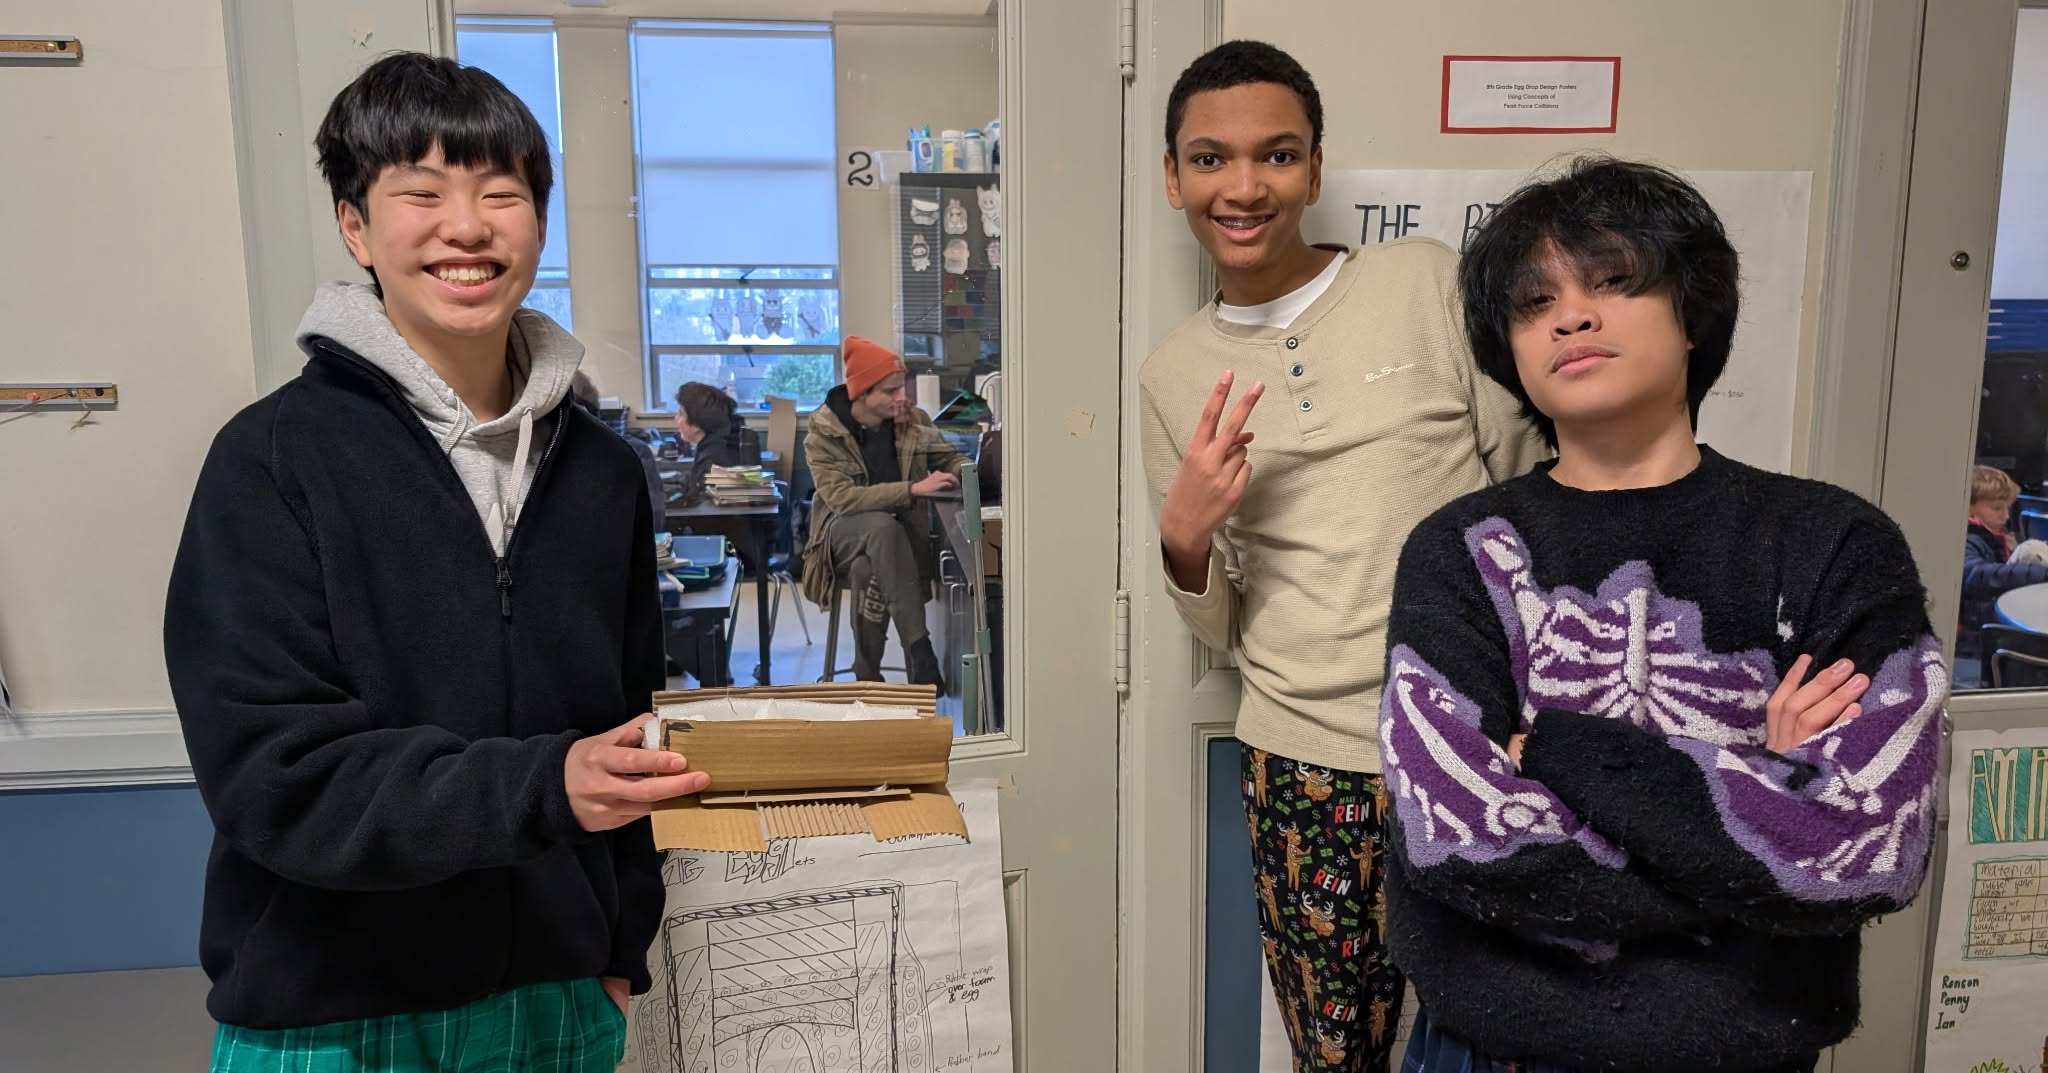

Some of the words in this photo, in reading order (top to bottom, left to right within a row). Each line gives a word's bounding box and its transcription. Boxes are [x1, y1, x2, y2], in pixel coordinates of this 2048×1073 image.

[847, 151, 874, 187] 2
[1334, 801, 1370, 824] REIN
[1322, 863, 1341, 876] MAKE
[1313, 868, 1352, 896] REIN
[948, 983, 966, 994] over
[969, 976, 996, 988] foam
[961, 988, 980, 1004] egg
[1322, 1000, 1359, 1022] REIN
[1940, 991, 1970, 1014] Penny
[1935, 1011, 1955, 1030] Ian
[947, 1053, 974, 1067] Rubber
[977, 1044, 1000, 1059] band
